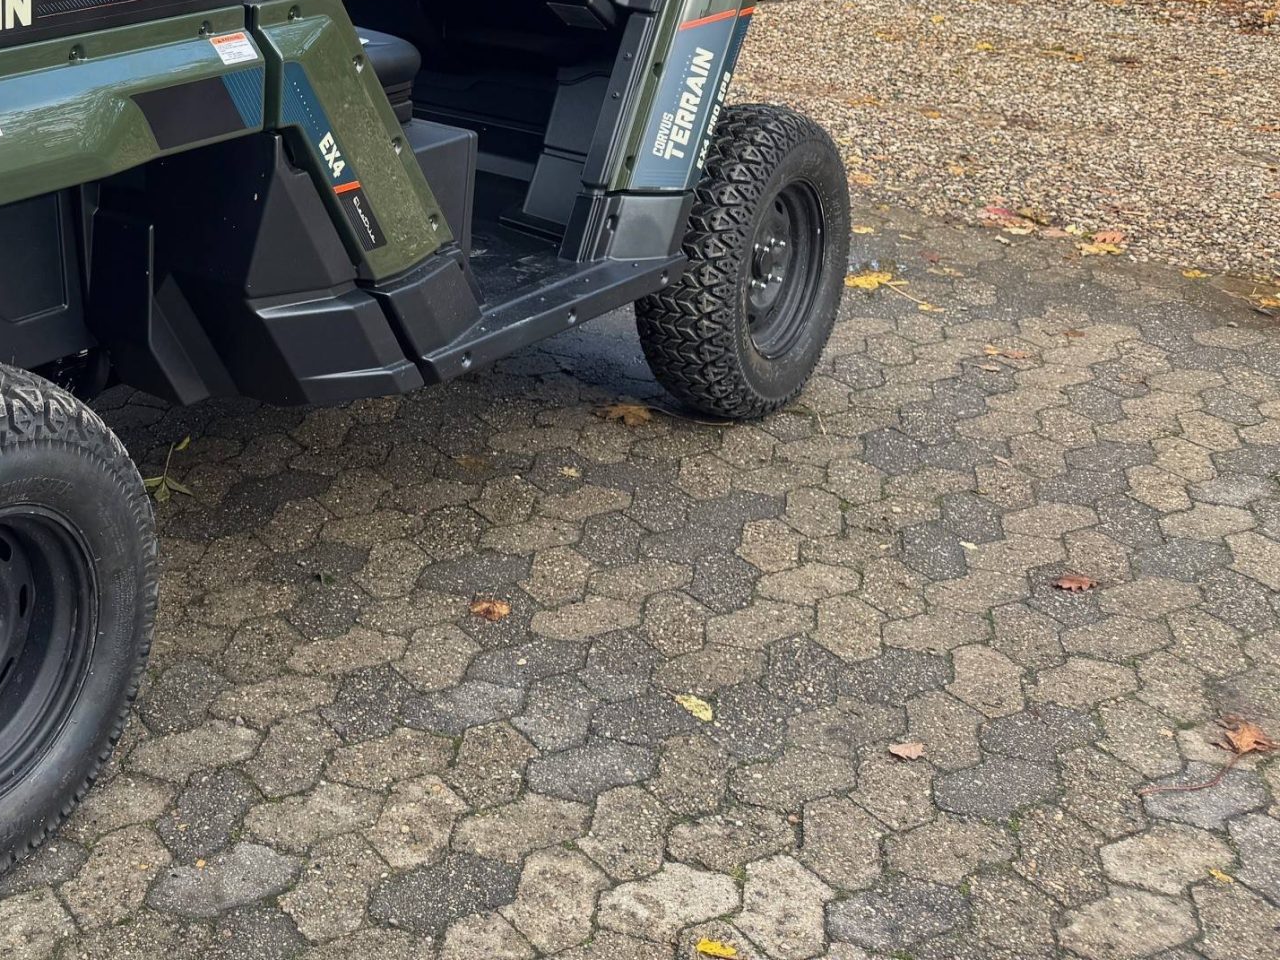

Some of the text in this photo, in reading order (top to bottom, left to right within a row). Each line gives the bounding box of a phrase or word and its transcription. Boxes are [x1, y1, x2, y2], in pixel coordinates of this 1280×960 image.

[664, 47, 715, 160] TERRAIN
[318, 131, 346, 179] EX4
[652, 111, 675, 157] CORVUS
[696, 139, 710, 170] EX4
[707, 106, 721, 137] PRO
